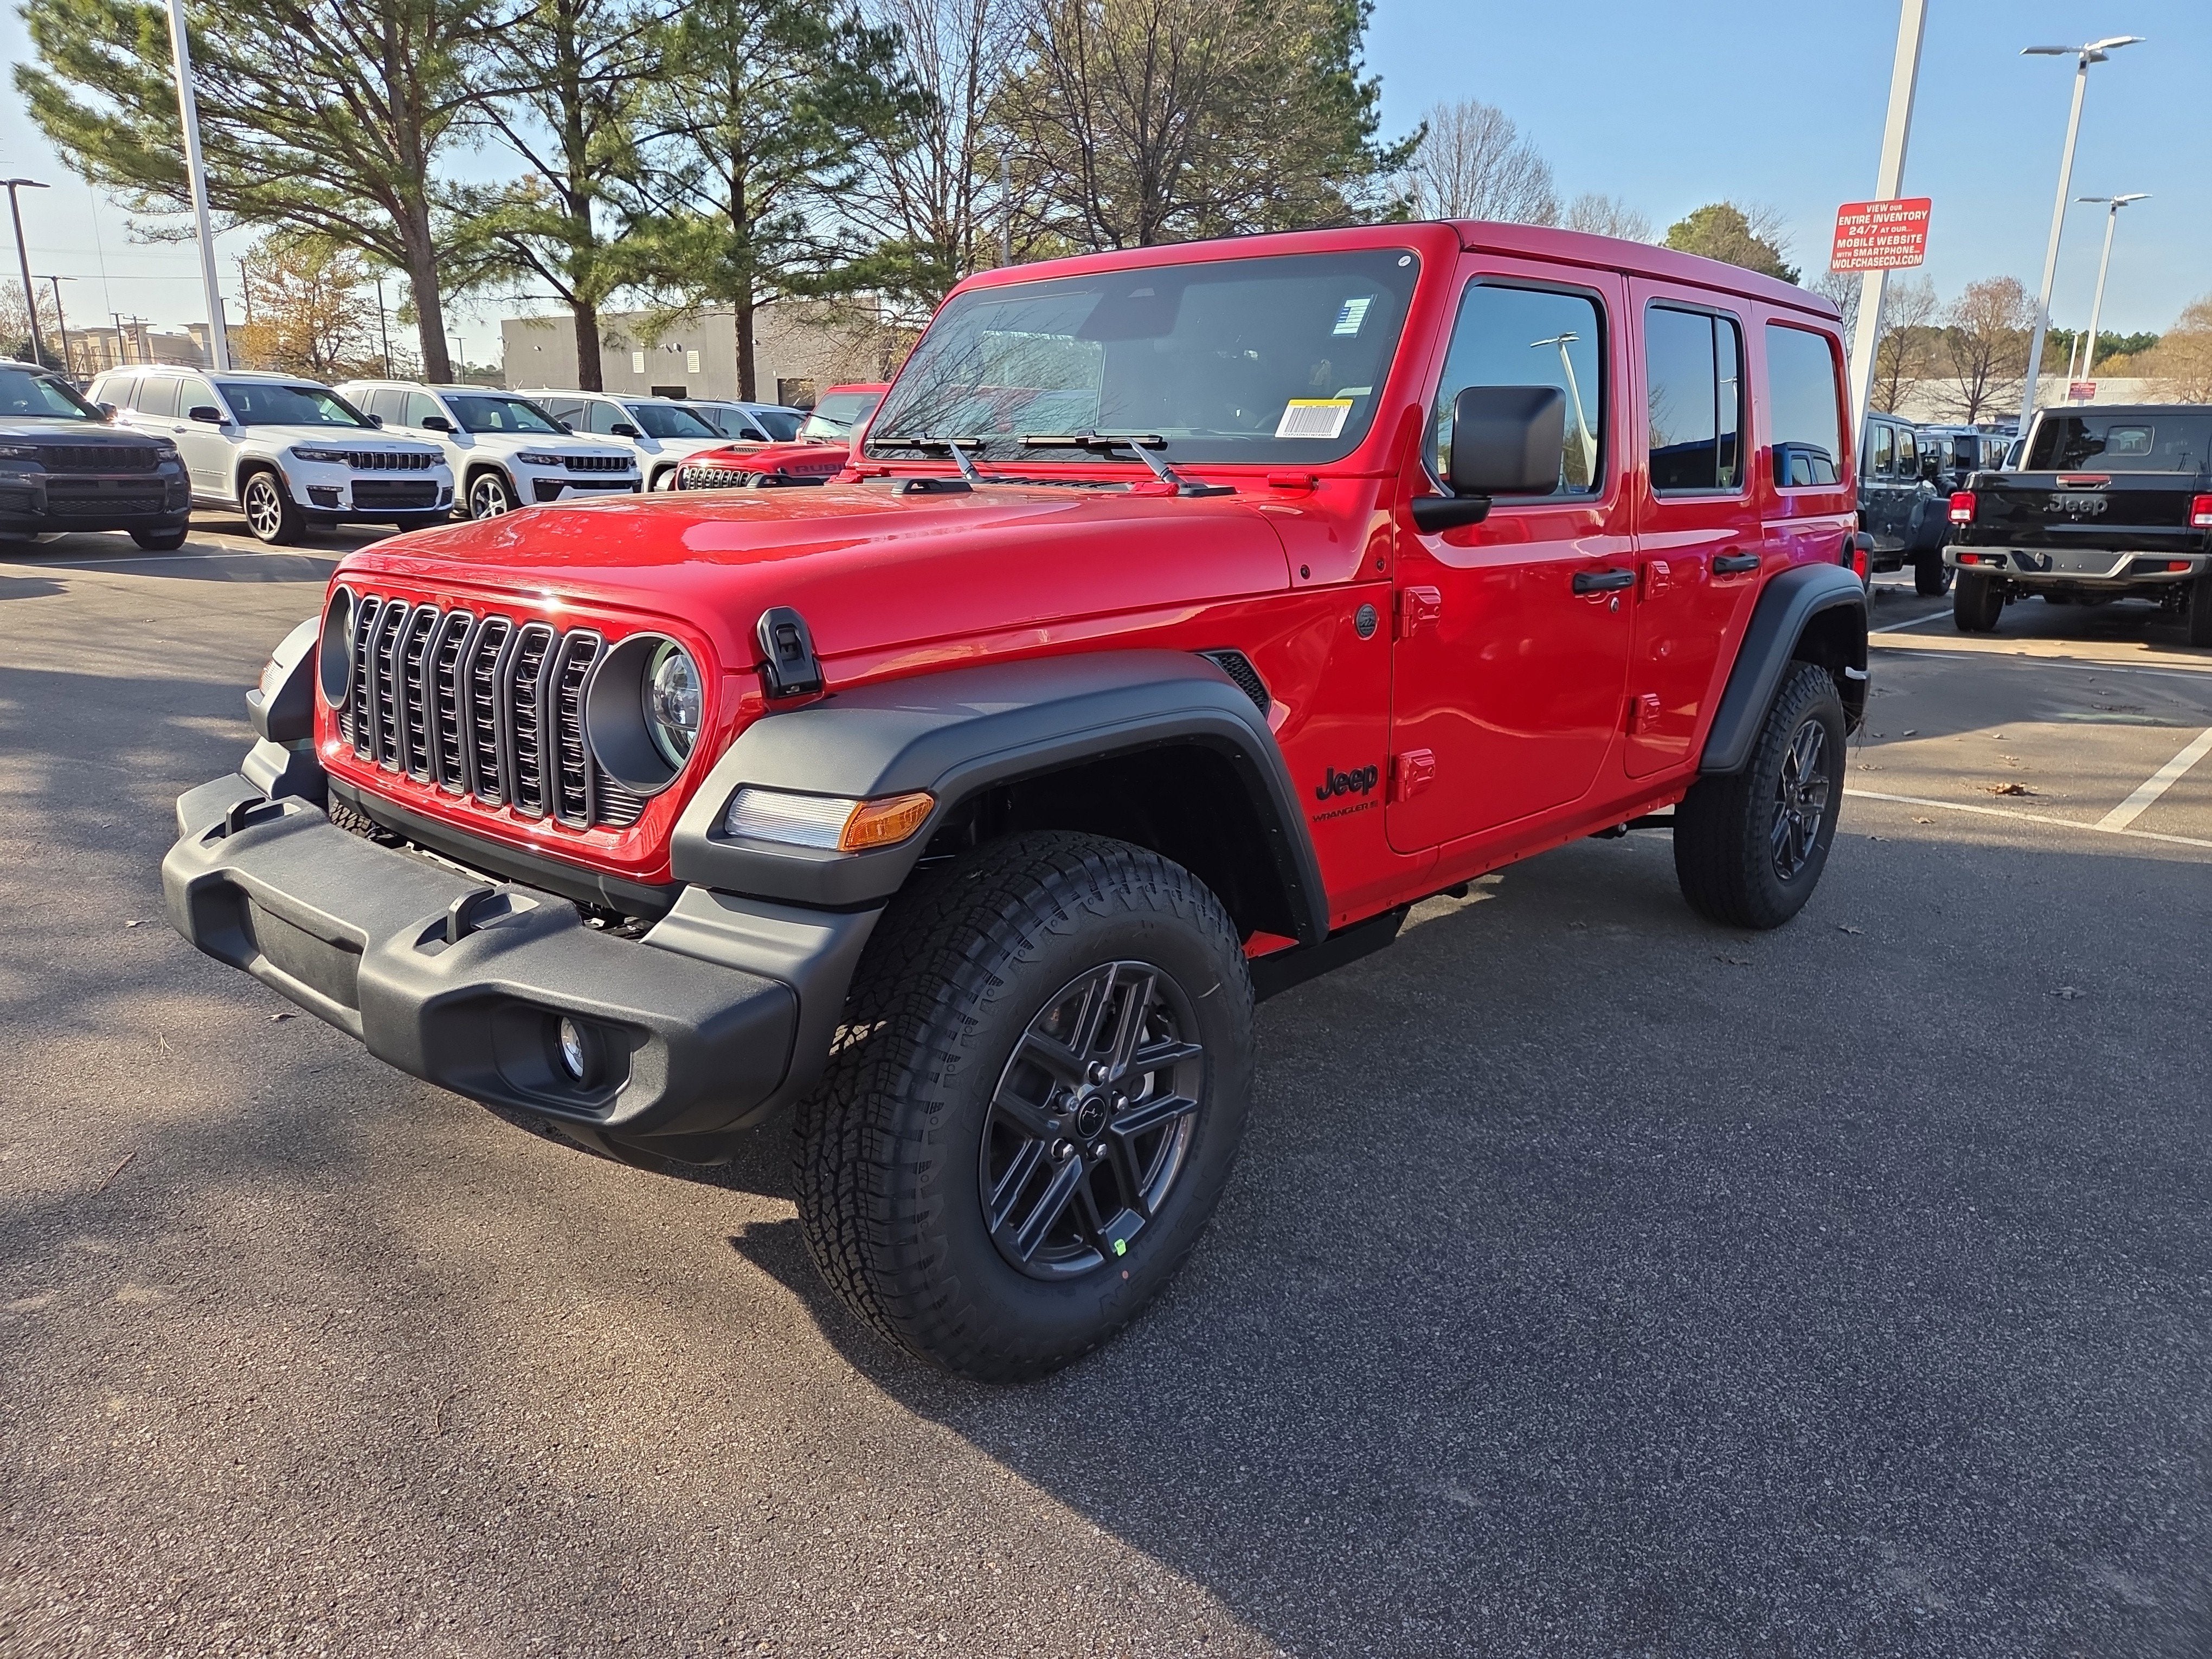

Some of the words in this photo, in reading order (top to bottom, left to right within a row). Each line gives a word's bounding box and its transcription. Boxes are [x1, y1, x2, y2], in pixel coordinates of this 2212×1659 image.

[1867, 204, 1888, 213] VIEW
[1838, 214, 1870, 226] ENTIRE
[1873, 210, 1928, 223] INVENTORY
[1849, 224, 1878, 235] 24/7
[1837, 237, 1875, 248] MOBILE
[1876, 234, 1922, 246] WEBSITE
[1832, 254, 1922, 268] WOLFCHASECDJ.COM
[2049, 494, 2108, 516] Jeep
[1316, 764, 1379, 801] Jeep
[1312, 802, 1368, 822] WRANGLER
